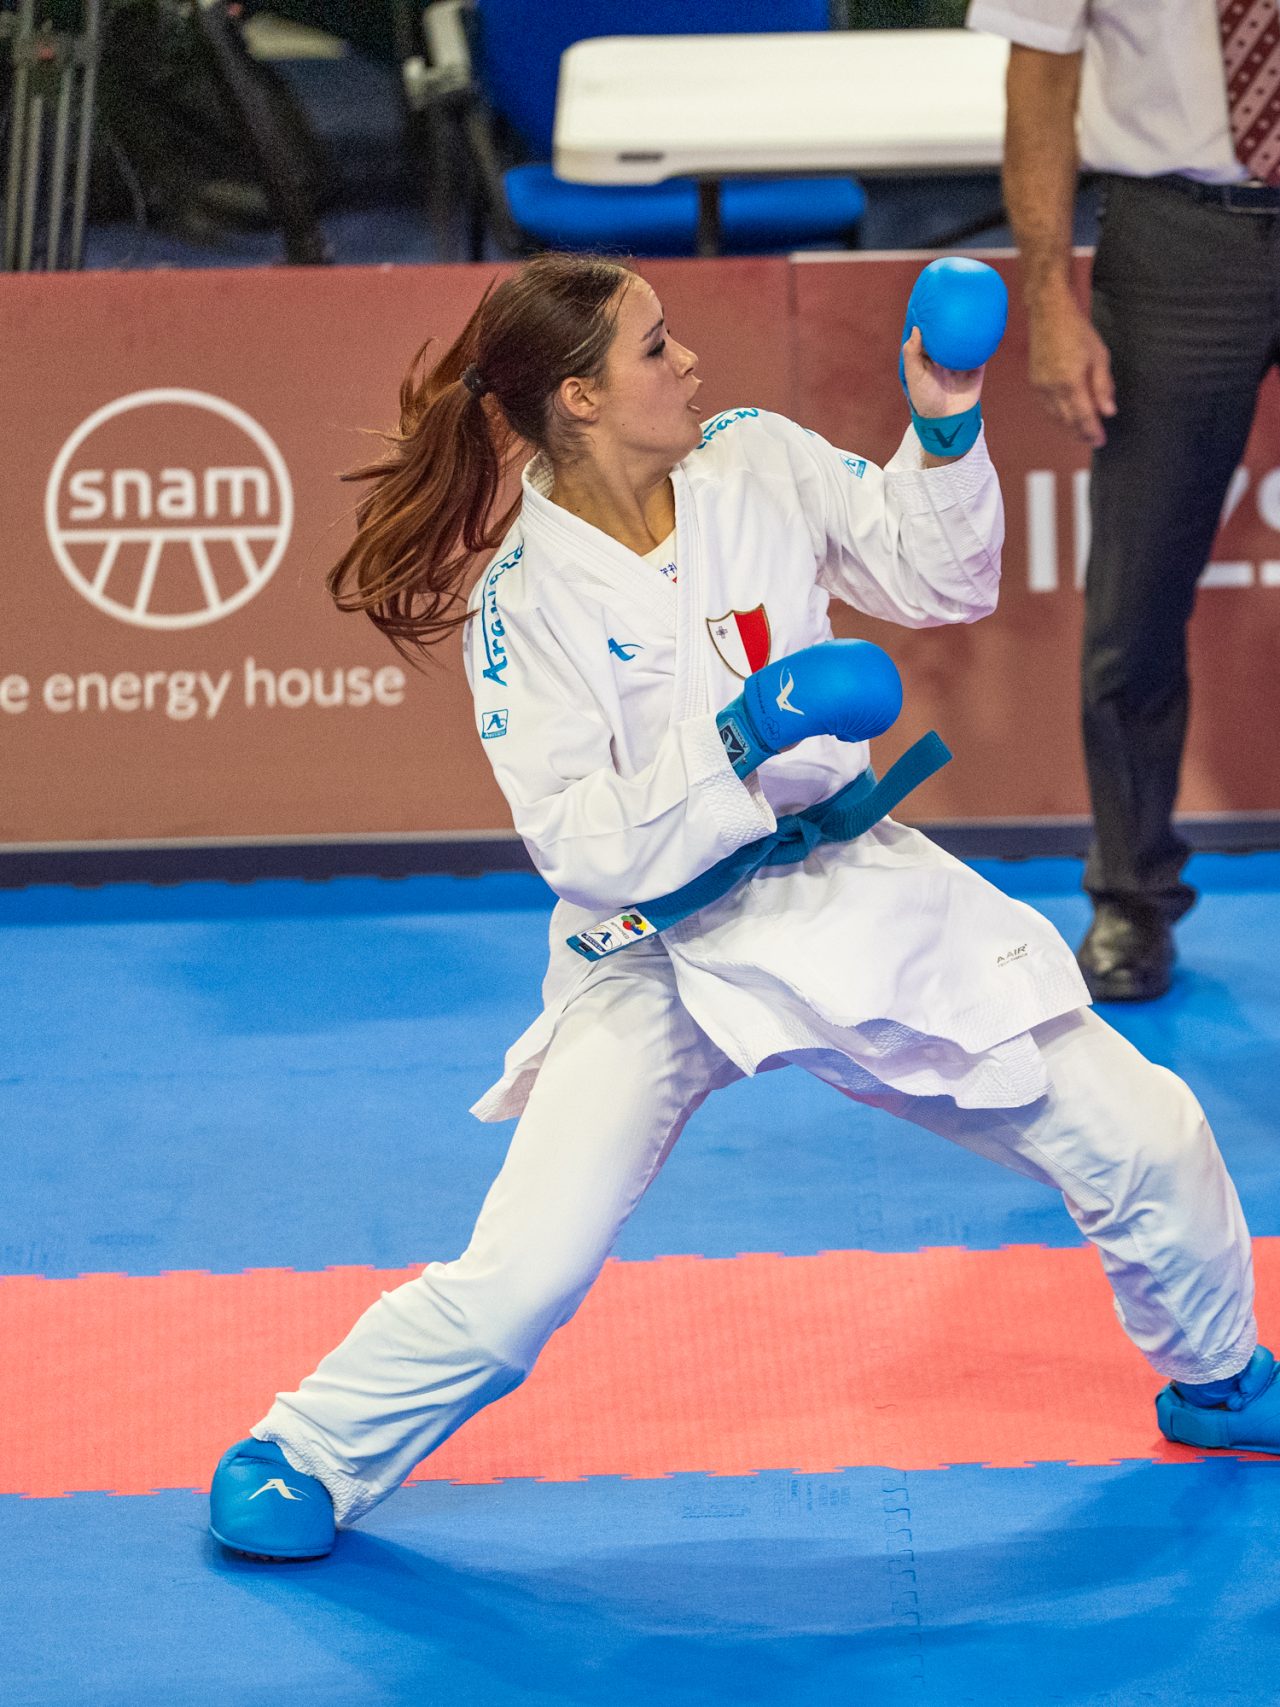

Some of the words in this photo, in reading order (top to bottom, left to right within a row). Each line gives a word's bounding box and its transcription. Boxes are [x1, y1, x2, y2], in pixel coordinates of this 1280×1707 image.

[68, 467, 271, 520] snam
[43, 669, 233, 721] energy
[244, 656, 406, 708] house
